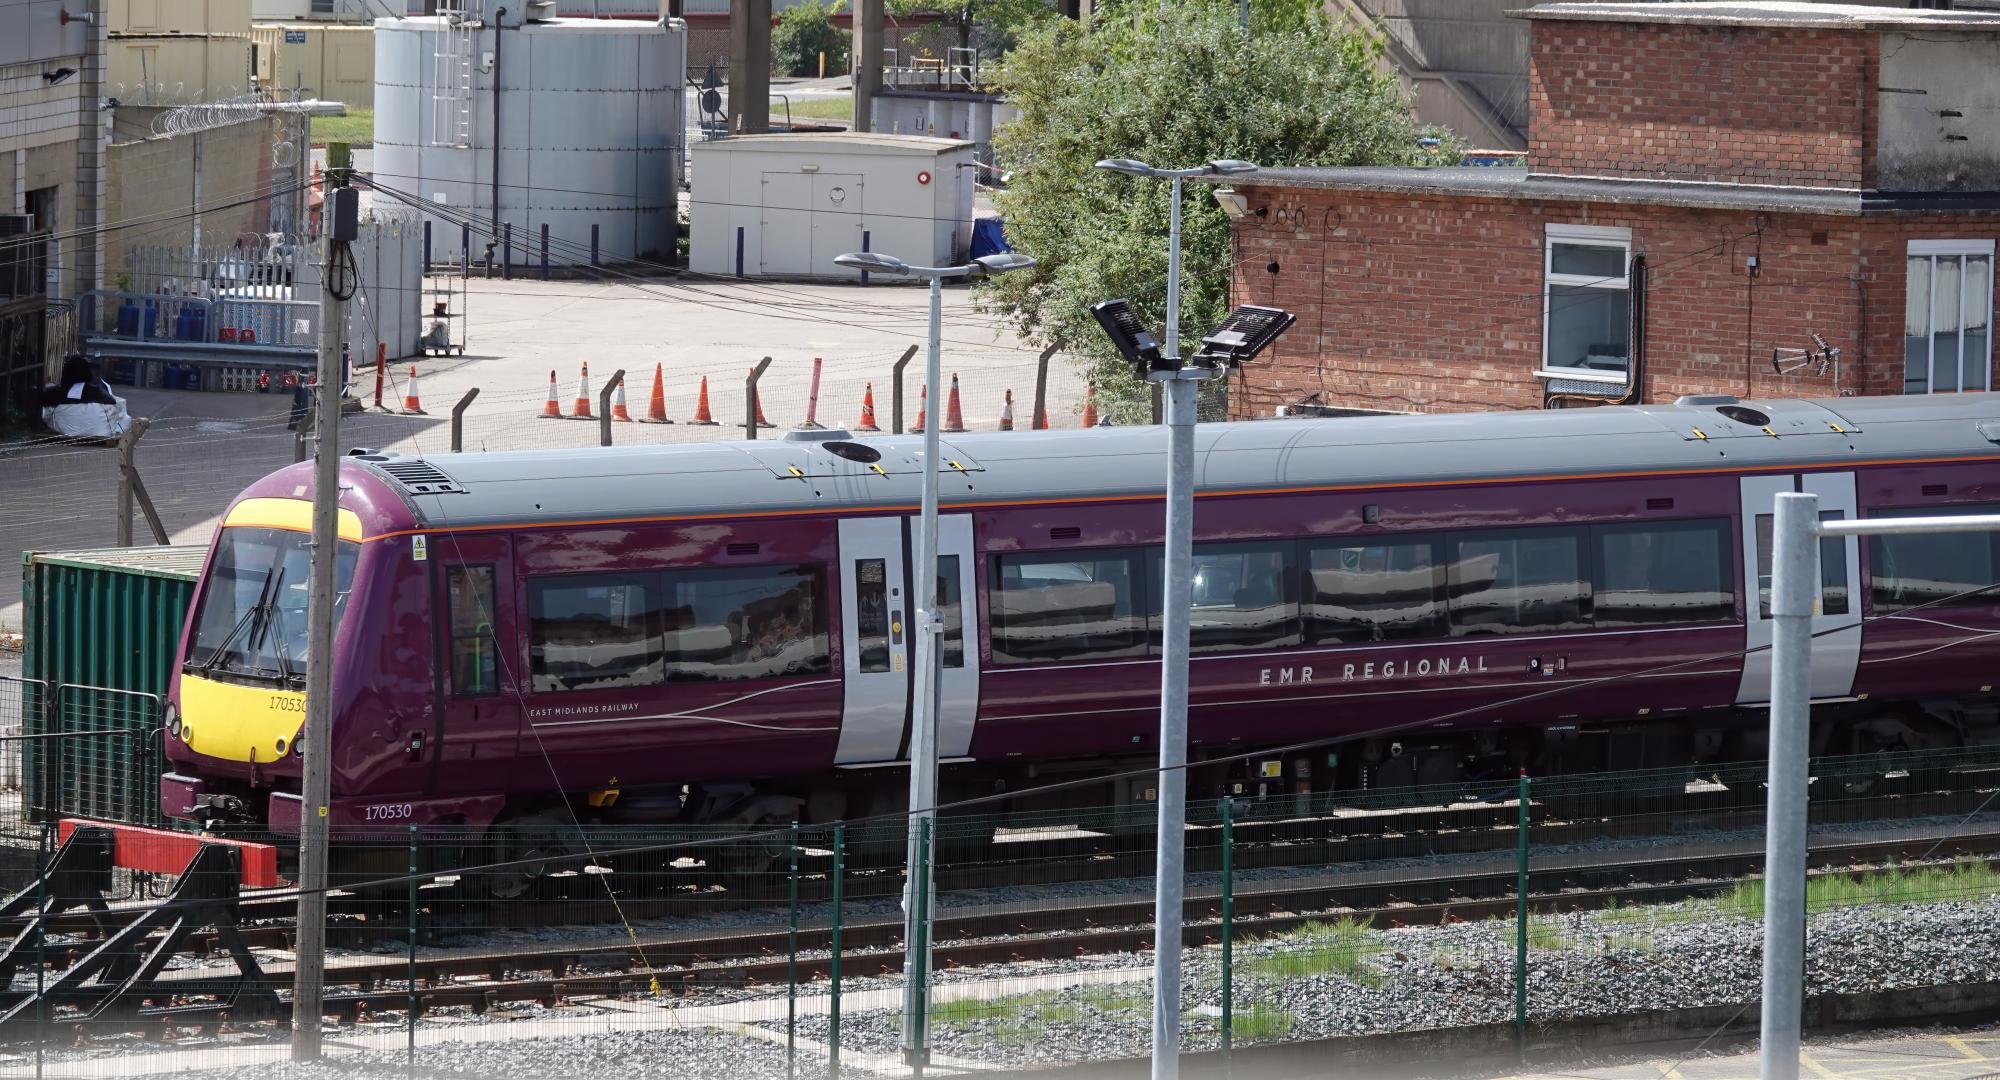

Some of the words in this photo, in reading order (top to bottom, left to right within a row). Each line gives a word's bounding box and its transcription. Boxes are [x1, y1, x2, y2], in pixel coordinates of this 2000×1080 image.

[1259, 666, 1313, 687] EMR
[1343, 655, 1488, 682] REGIONAL
[530, 708, 552, 717] EAST
[555, 705, 599, 716] MIDLANDS
[602, 703, 639, 713] RAILWAY
[365, 803, 412, 820] 170530
